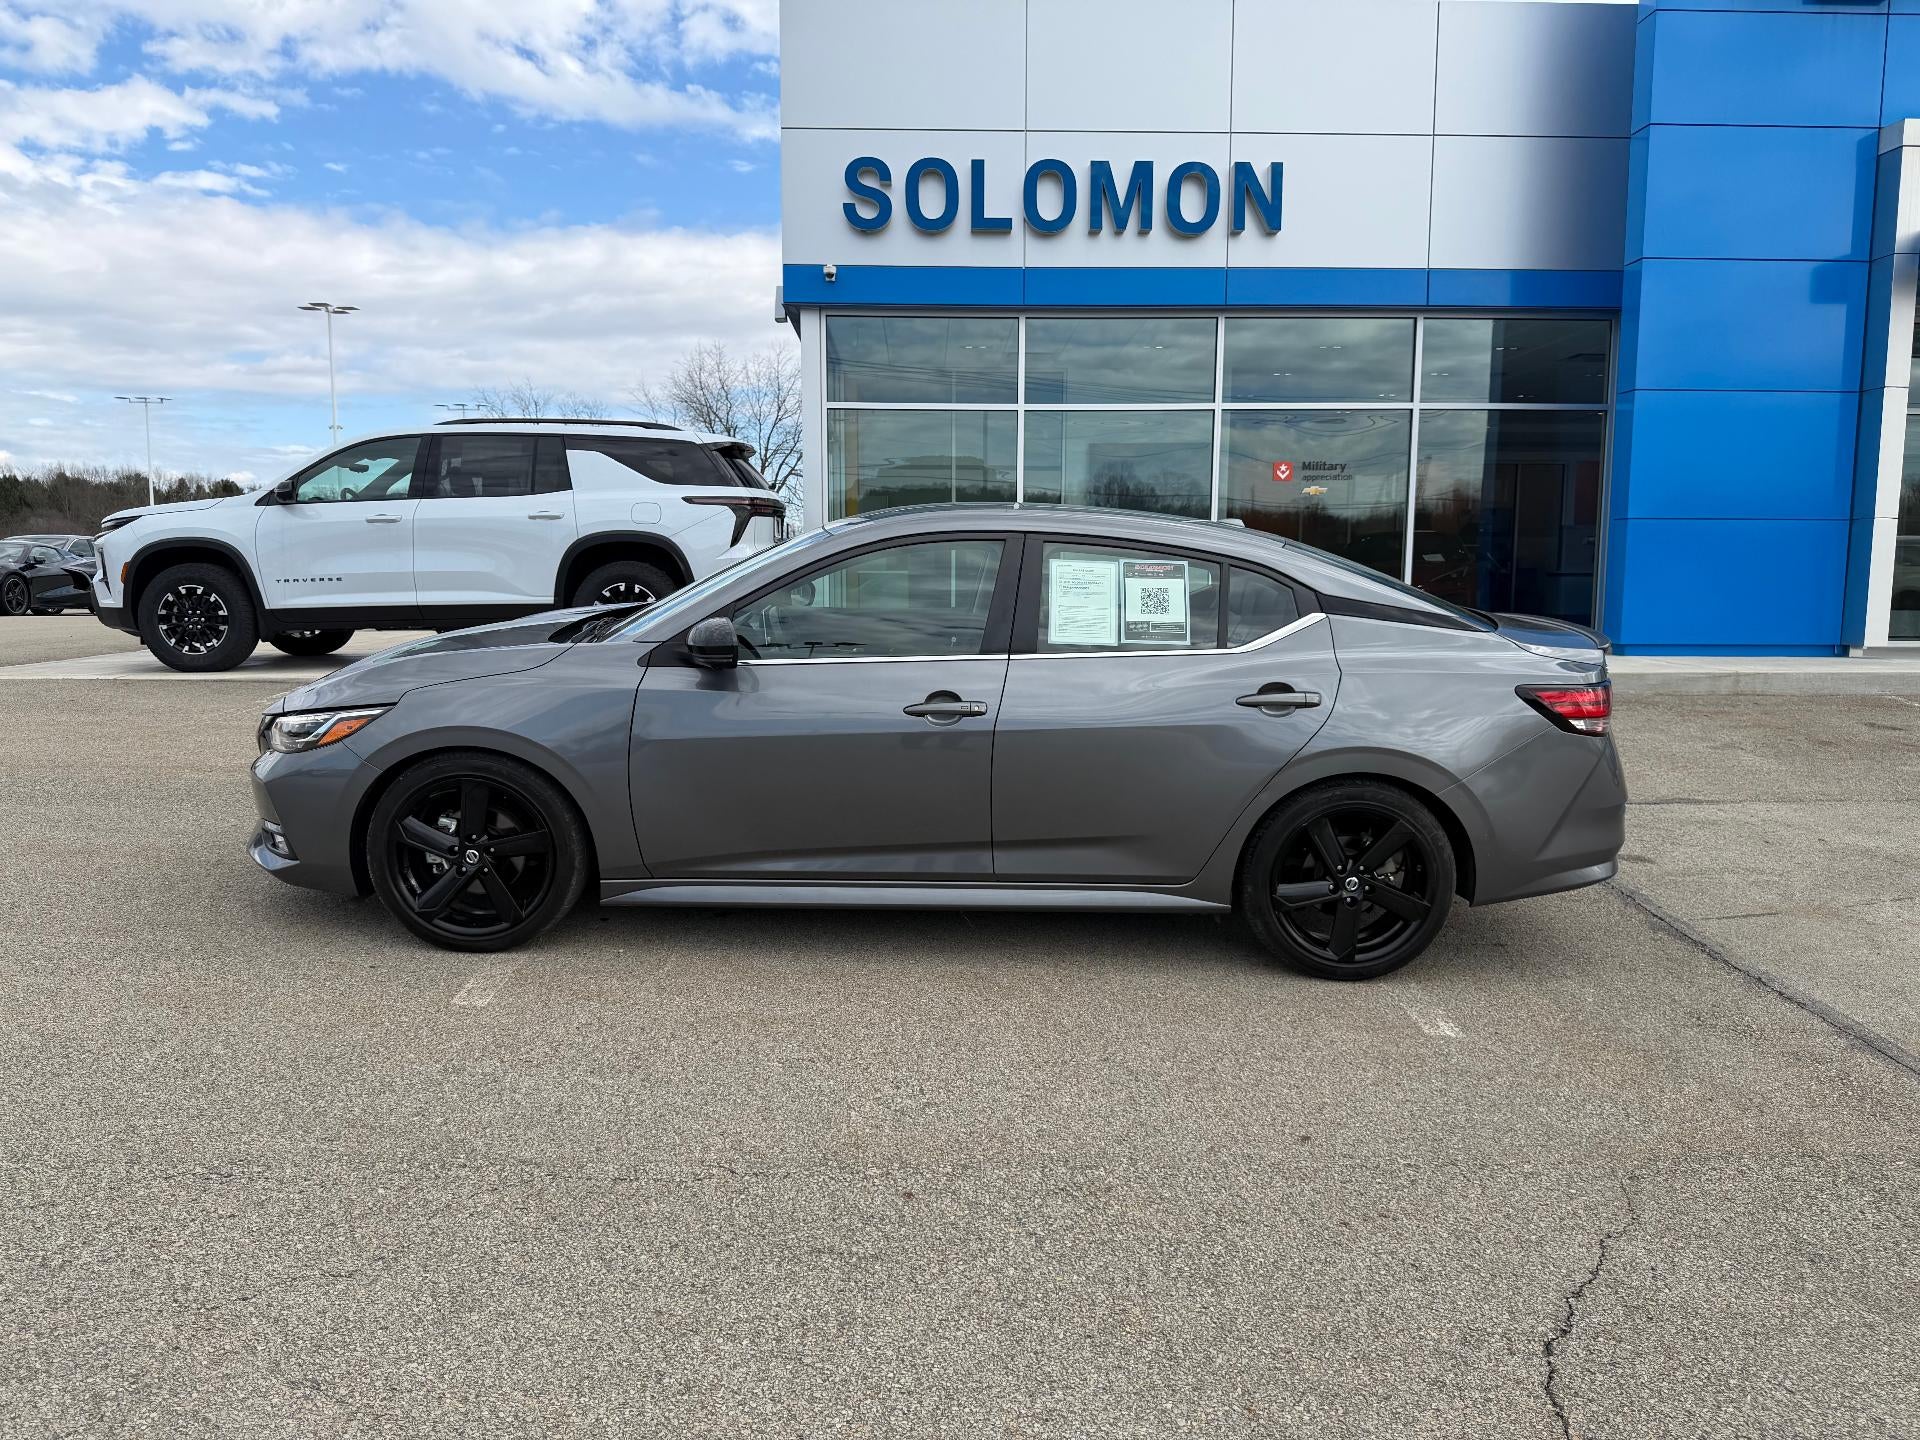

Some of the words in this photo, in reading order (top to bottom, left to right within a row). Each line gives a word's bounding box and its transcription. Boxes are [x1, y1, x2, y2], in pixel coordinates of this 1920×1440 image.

[842, 156, 1284, 236] SOLOMON
[1302, 461, 1347, 472] Military
[1302, 474, 1353, 482] appreciation
